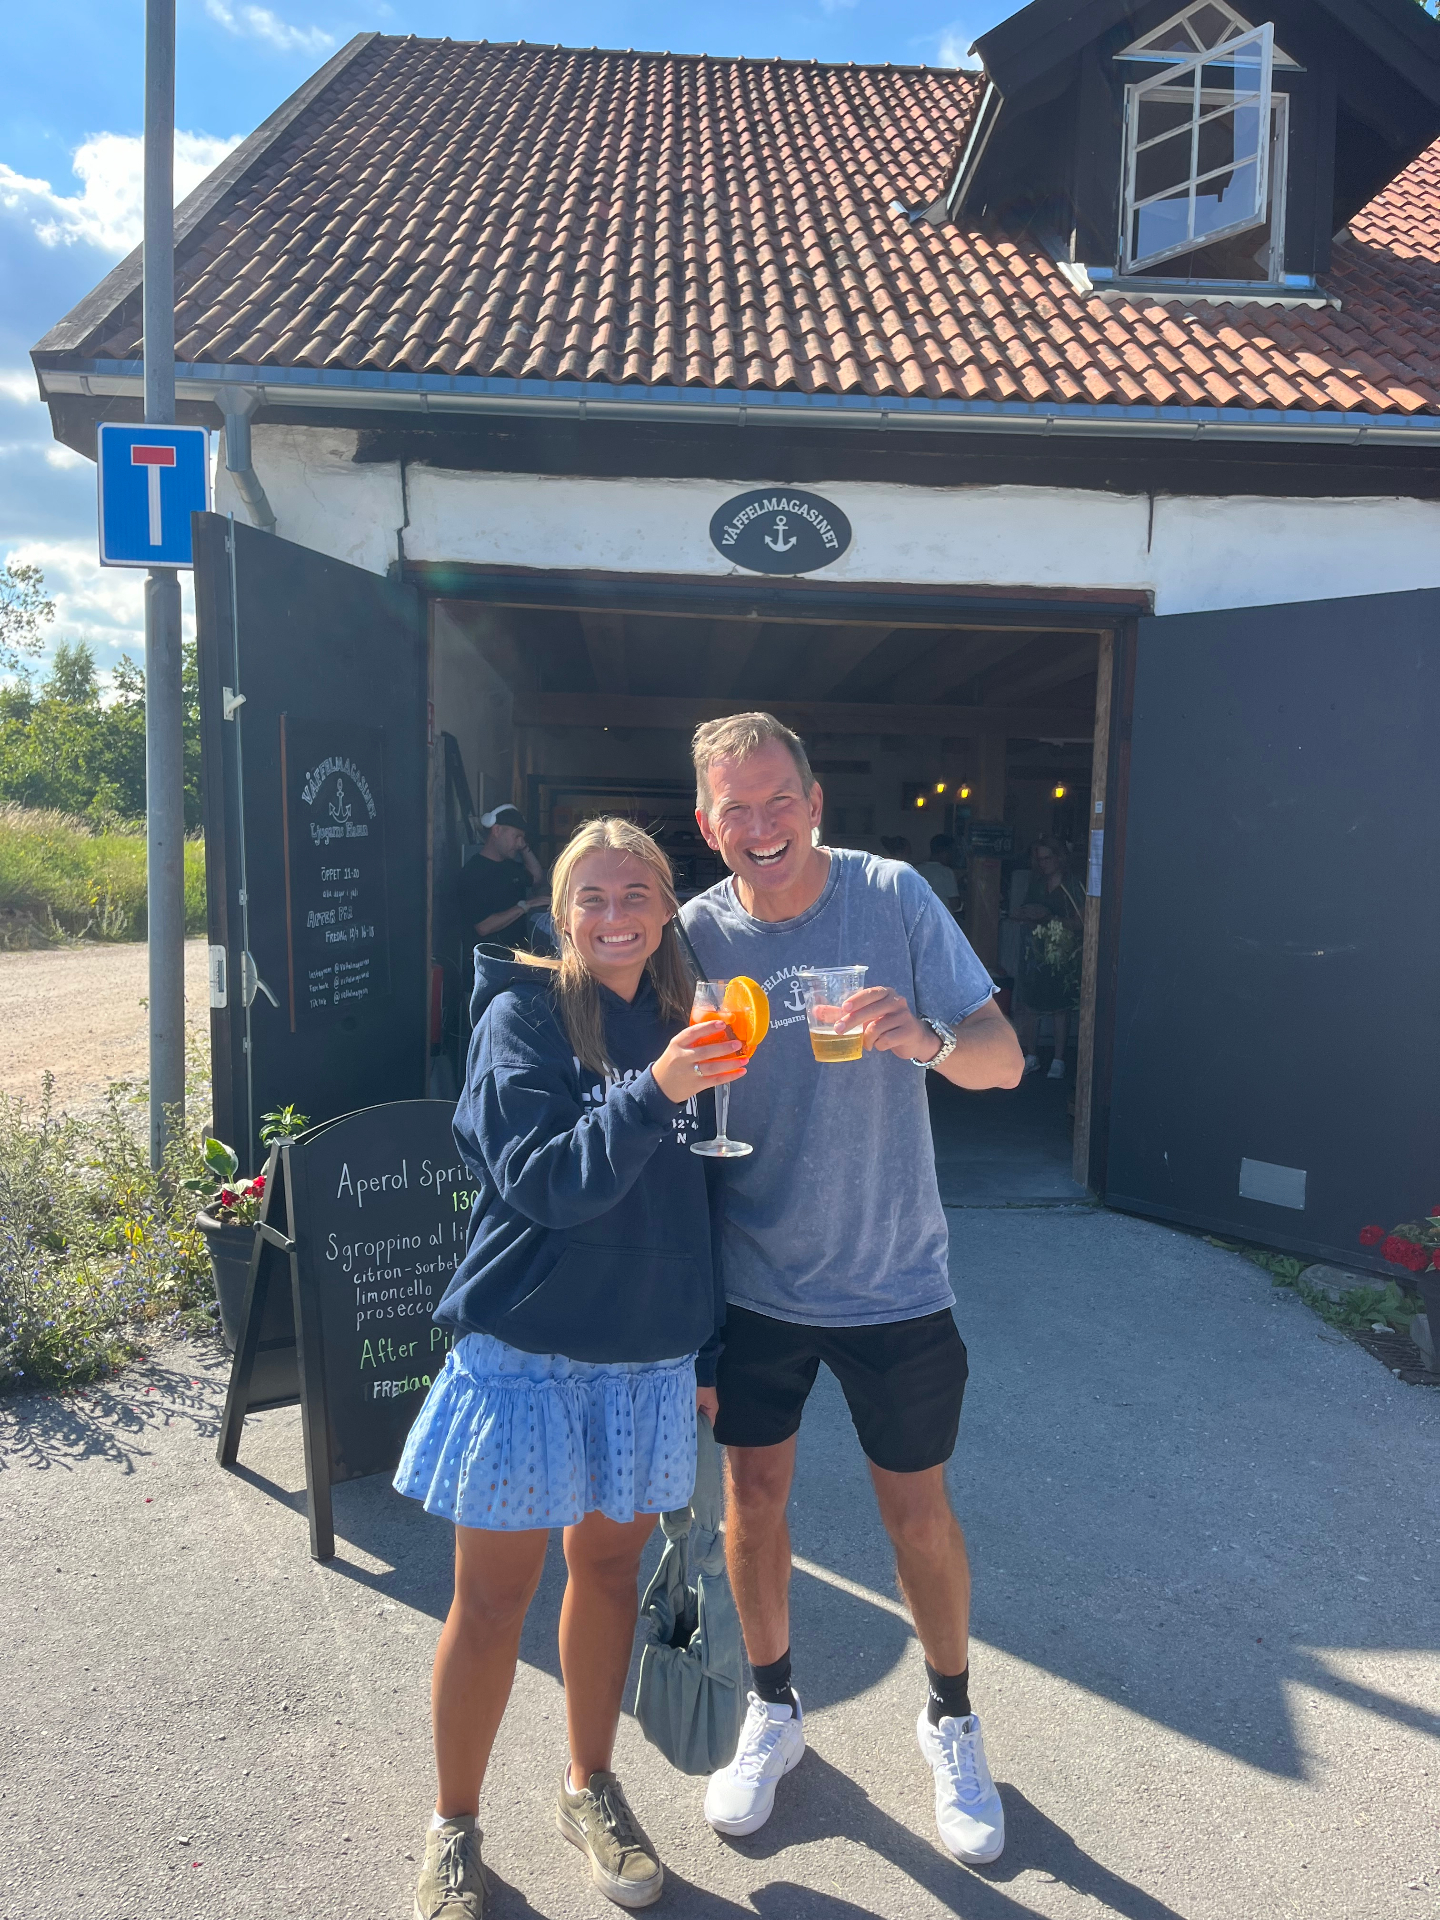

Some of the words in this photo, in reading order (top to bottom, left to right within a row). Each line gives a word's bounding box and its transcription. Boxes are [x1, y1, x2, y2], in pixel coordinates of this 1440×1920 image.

[722, 497, 839, 549] VÅFFELMAGASINET
[320, 866, 341, 882] ÖPPET
[770, 1014, 806, 1029] Ljugarns
[337, 1159, 408, 1208] Aperol
[419, 1159, 473, 1195] Sprit
[325, 1233, 421, 1272] Sgroppino
[429, 1223, 442, 1246] al
[452, 1221, 468, 1242] li
[356, 1279, 432, 1305] limoncello
[356, 1301, 434, 1331] prosecco
[360, 1338, 418, 1369] After
